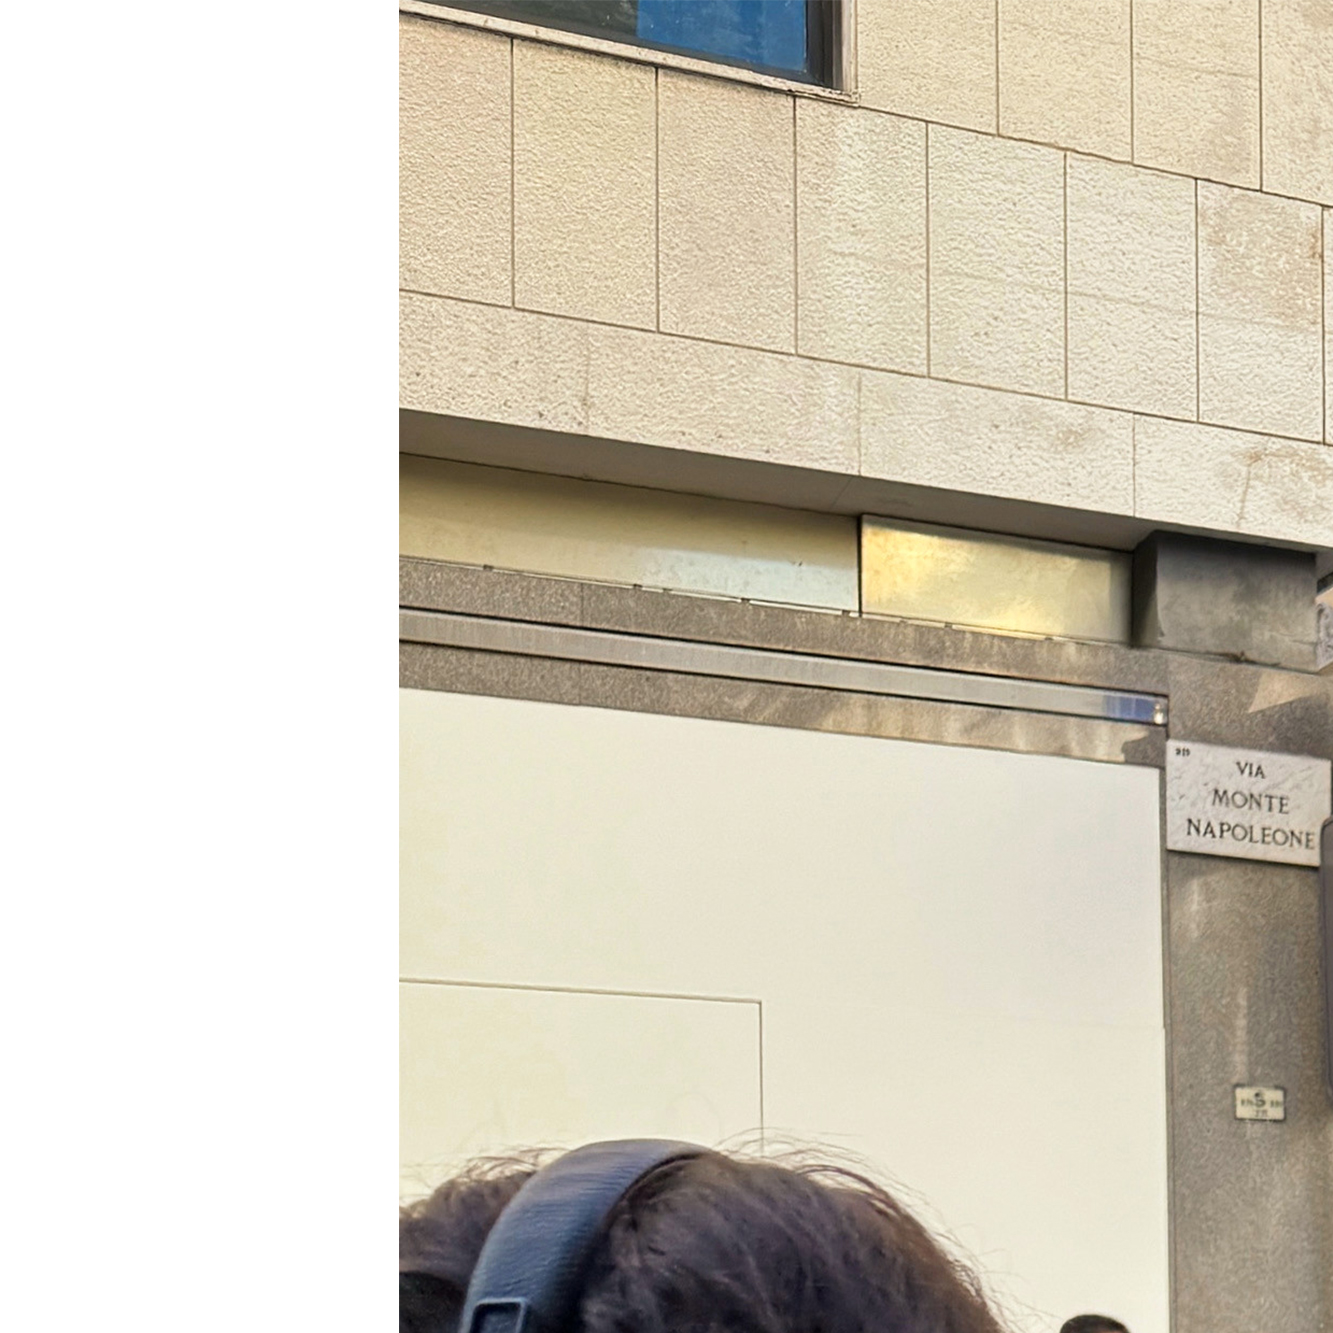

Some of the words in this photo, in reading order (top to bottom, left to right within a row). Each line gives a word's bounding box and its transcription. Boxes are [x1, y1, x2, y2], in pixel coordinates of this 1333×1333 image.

[1236, 761, 1266, 779] VIA
[1211, 788, 1290, 814] MONTE
[1186, 818, 1316, 849] NAPOLEONE
